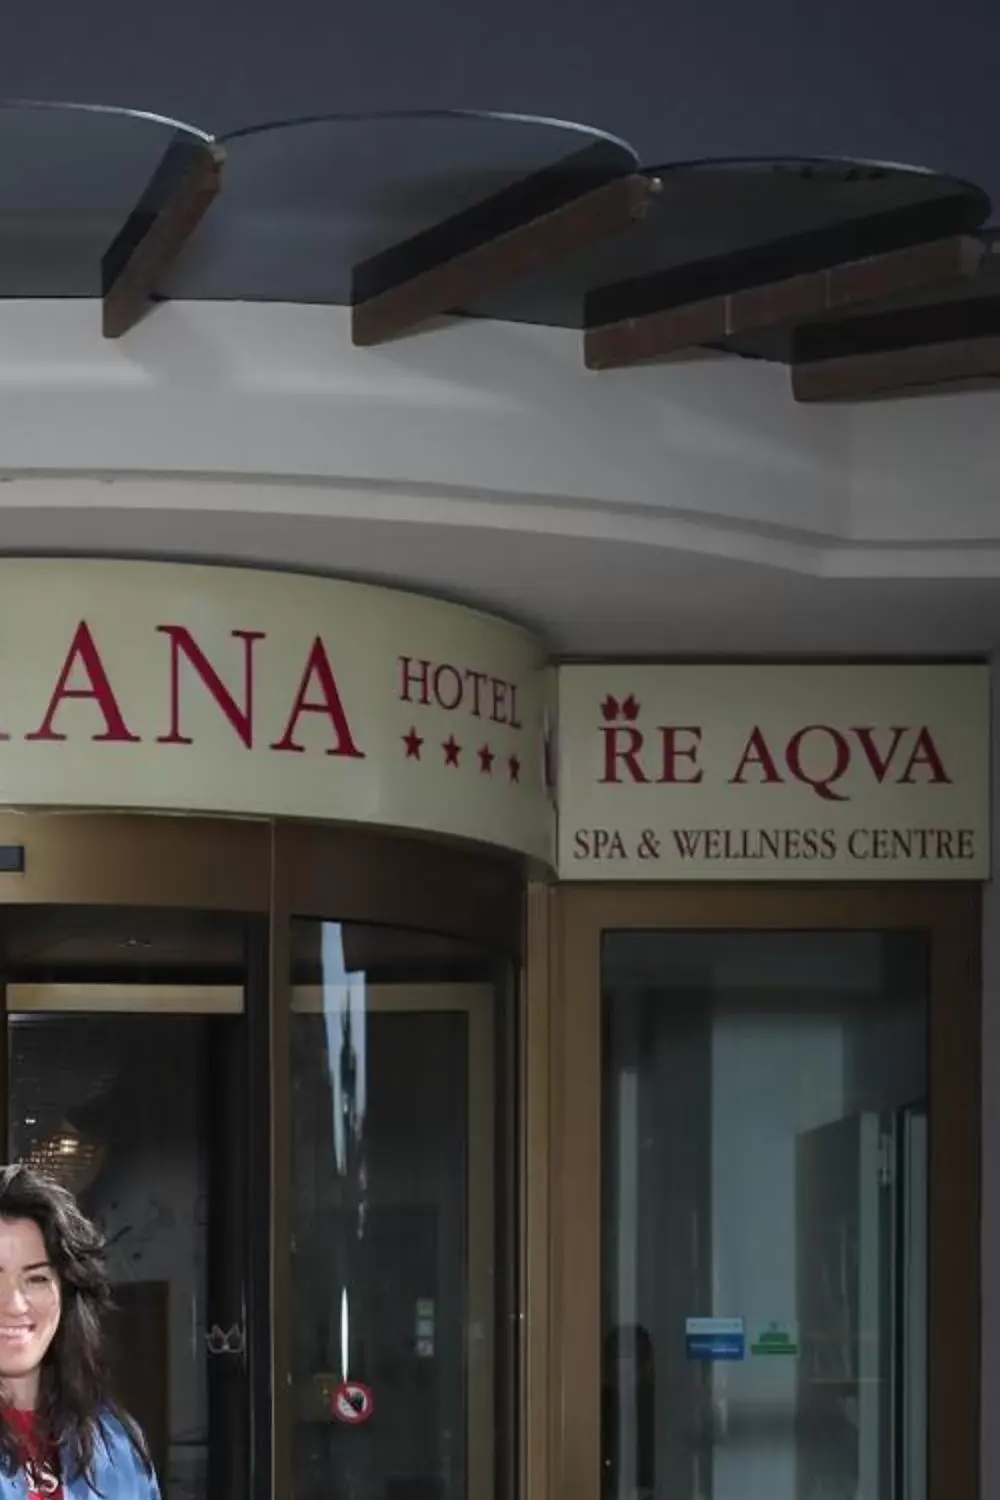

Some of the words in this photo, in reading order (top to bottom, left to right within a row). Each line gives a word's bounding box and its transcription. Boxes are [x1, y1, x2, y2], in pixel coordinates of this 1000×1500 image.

[398, 655, 522, 730] HOTEL
[596, 725, 704, 785] RE
[728, 724, 954, 802] AQVA
[572, 828, 628, 860] SPA
[636, 829, 661, 860] &
[670, 828, 837, 860] WELLNESS
[847, 828, 976, 860] CENTRE
